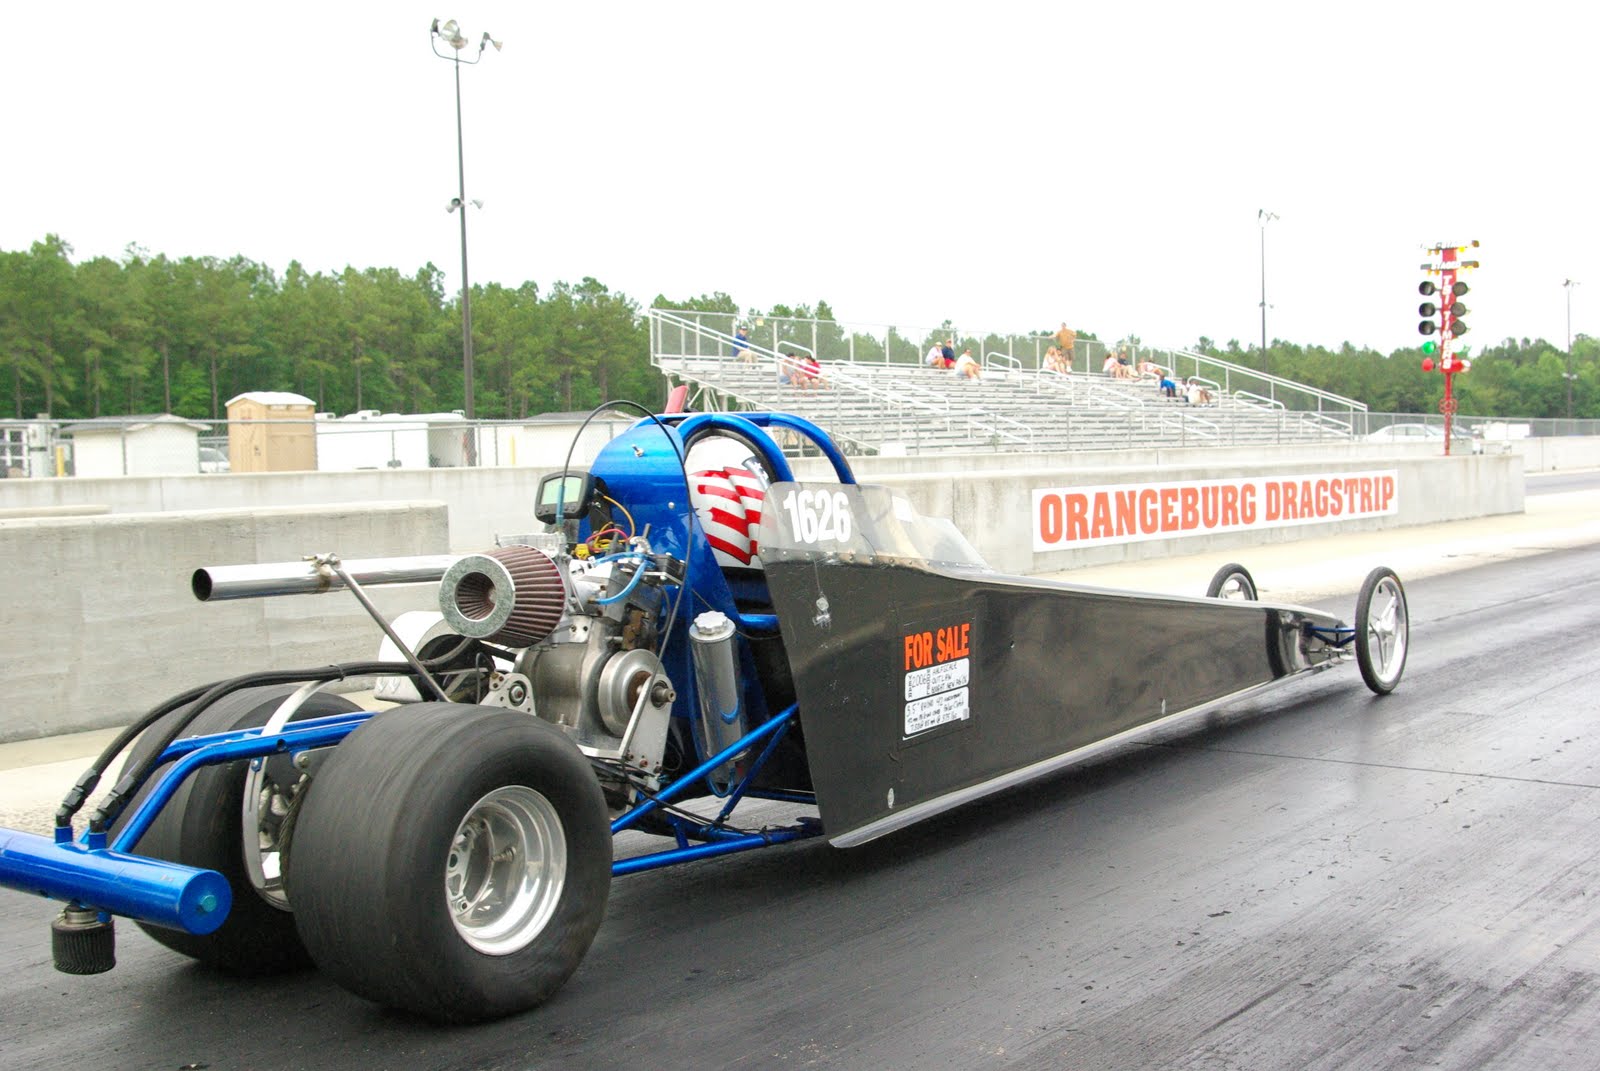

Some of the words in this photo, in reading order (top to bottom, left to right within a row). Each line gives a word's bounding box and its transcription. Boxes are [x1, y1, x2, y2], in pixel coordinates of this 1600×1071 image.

[783, 489, 851, 544] 1626
[1040, 484, 1256, 543] ORANGEBURG
[1265, 476, 1394, 521] DRAGSTRIP
[905, 632, 933, 671] FOR
[937, 623, 969, 662] SALE
